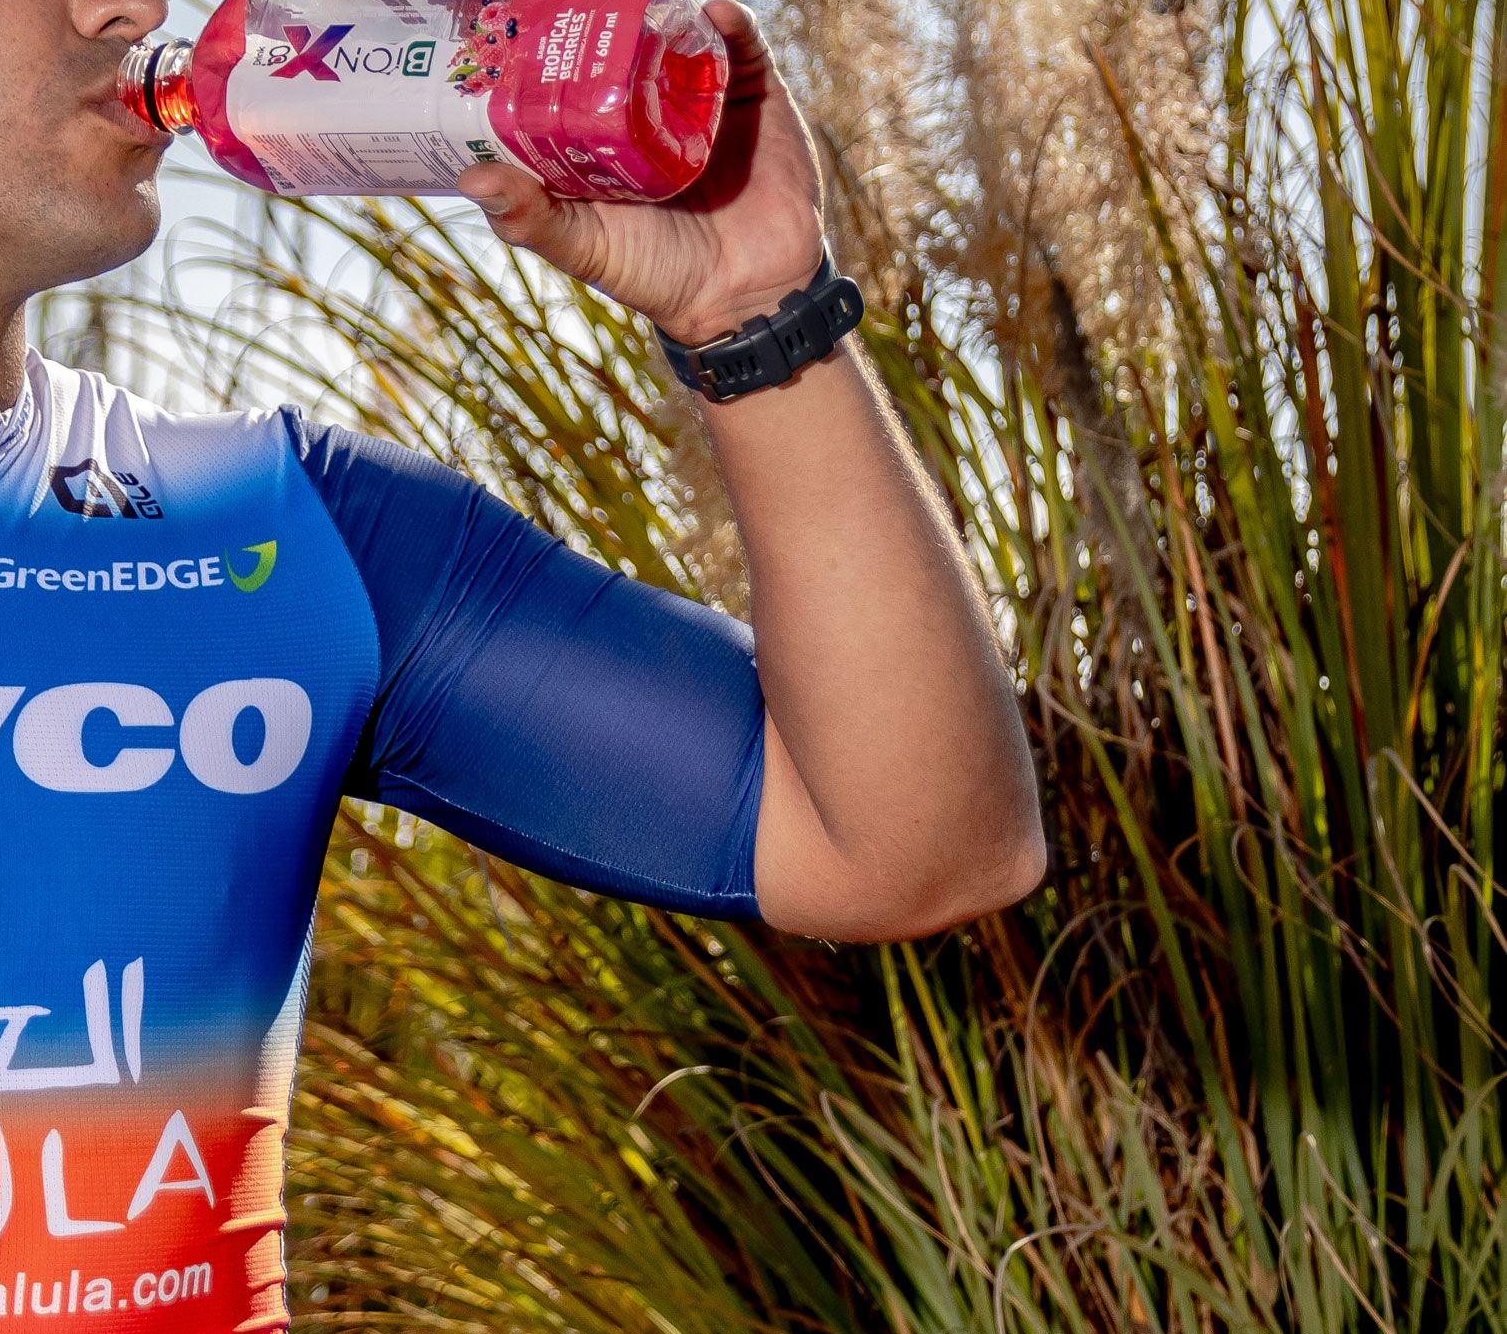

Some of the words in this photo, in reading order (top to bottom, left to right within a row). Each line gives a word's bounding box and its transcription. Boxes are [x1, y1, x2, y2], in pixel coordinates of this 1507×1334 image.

[537, 36, 547, 60] SABOR
[540, 7, 573, 83] TROPICAL
[559, 12, 586, 80] BERRIES
[595, 30, 613, 57] 600
